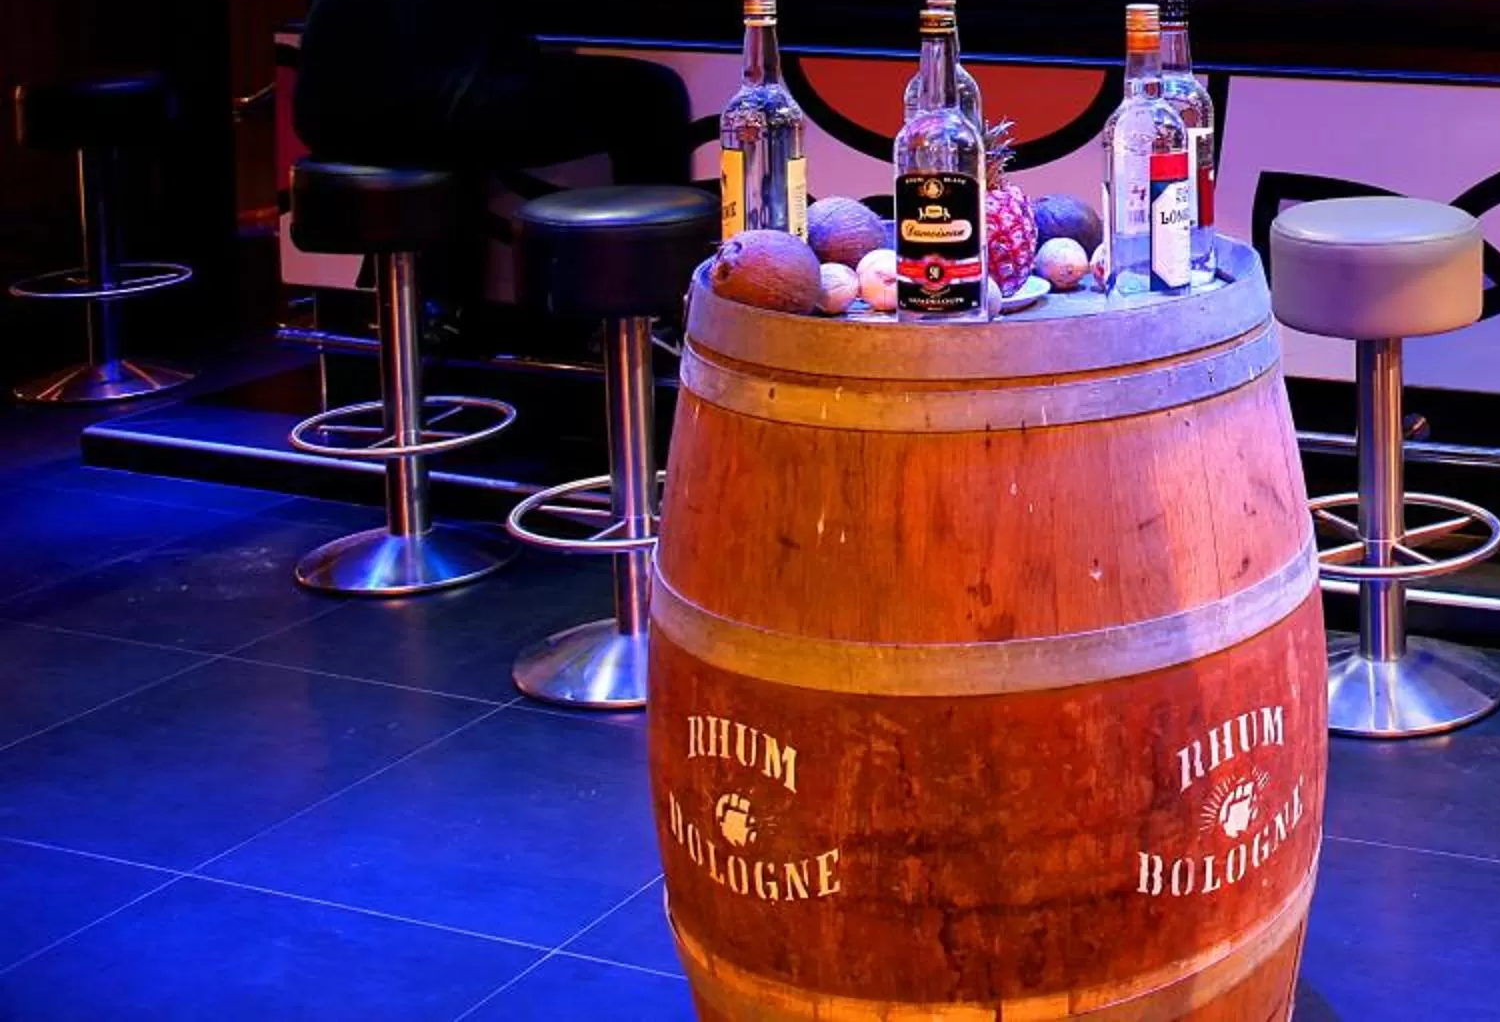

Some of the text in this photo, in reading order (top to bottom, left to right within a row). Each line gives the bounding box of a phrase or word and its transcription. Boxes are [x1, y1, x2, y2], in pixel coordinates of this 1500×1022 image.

[687, 714, 797, 794] RHUM
[1176, 705, 1284, 793] RHUM
[669, 791, 841, 902] BOLOGNE
[1136, 774, 1304, 897] BOLOGNE
